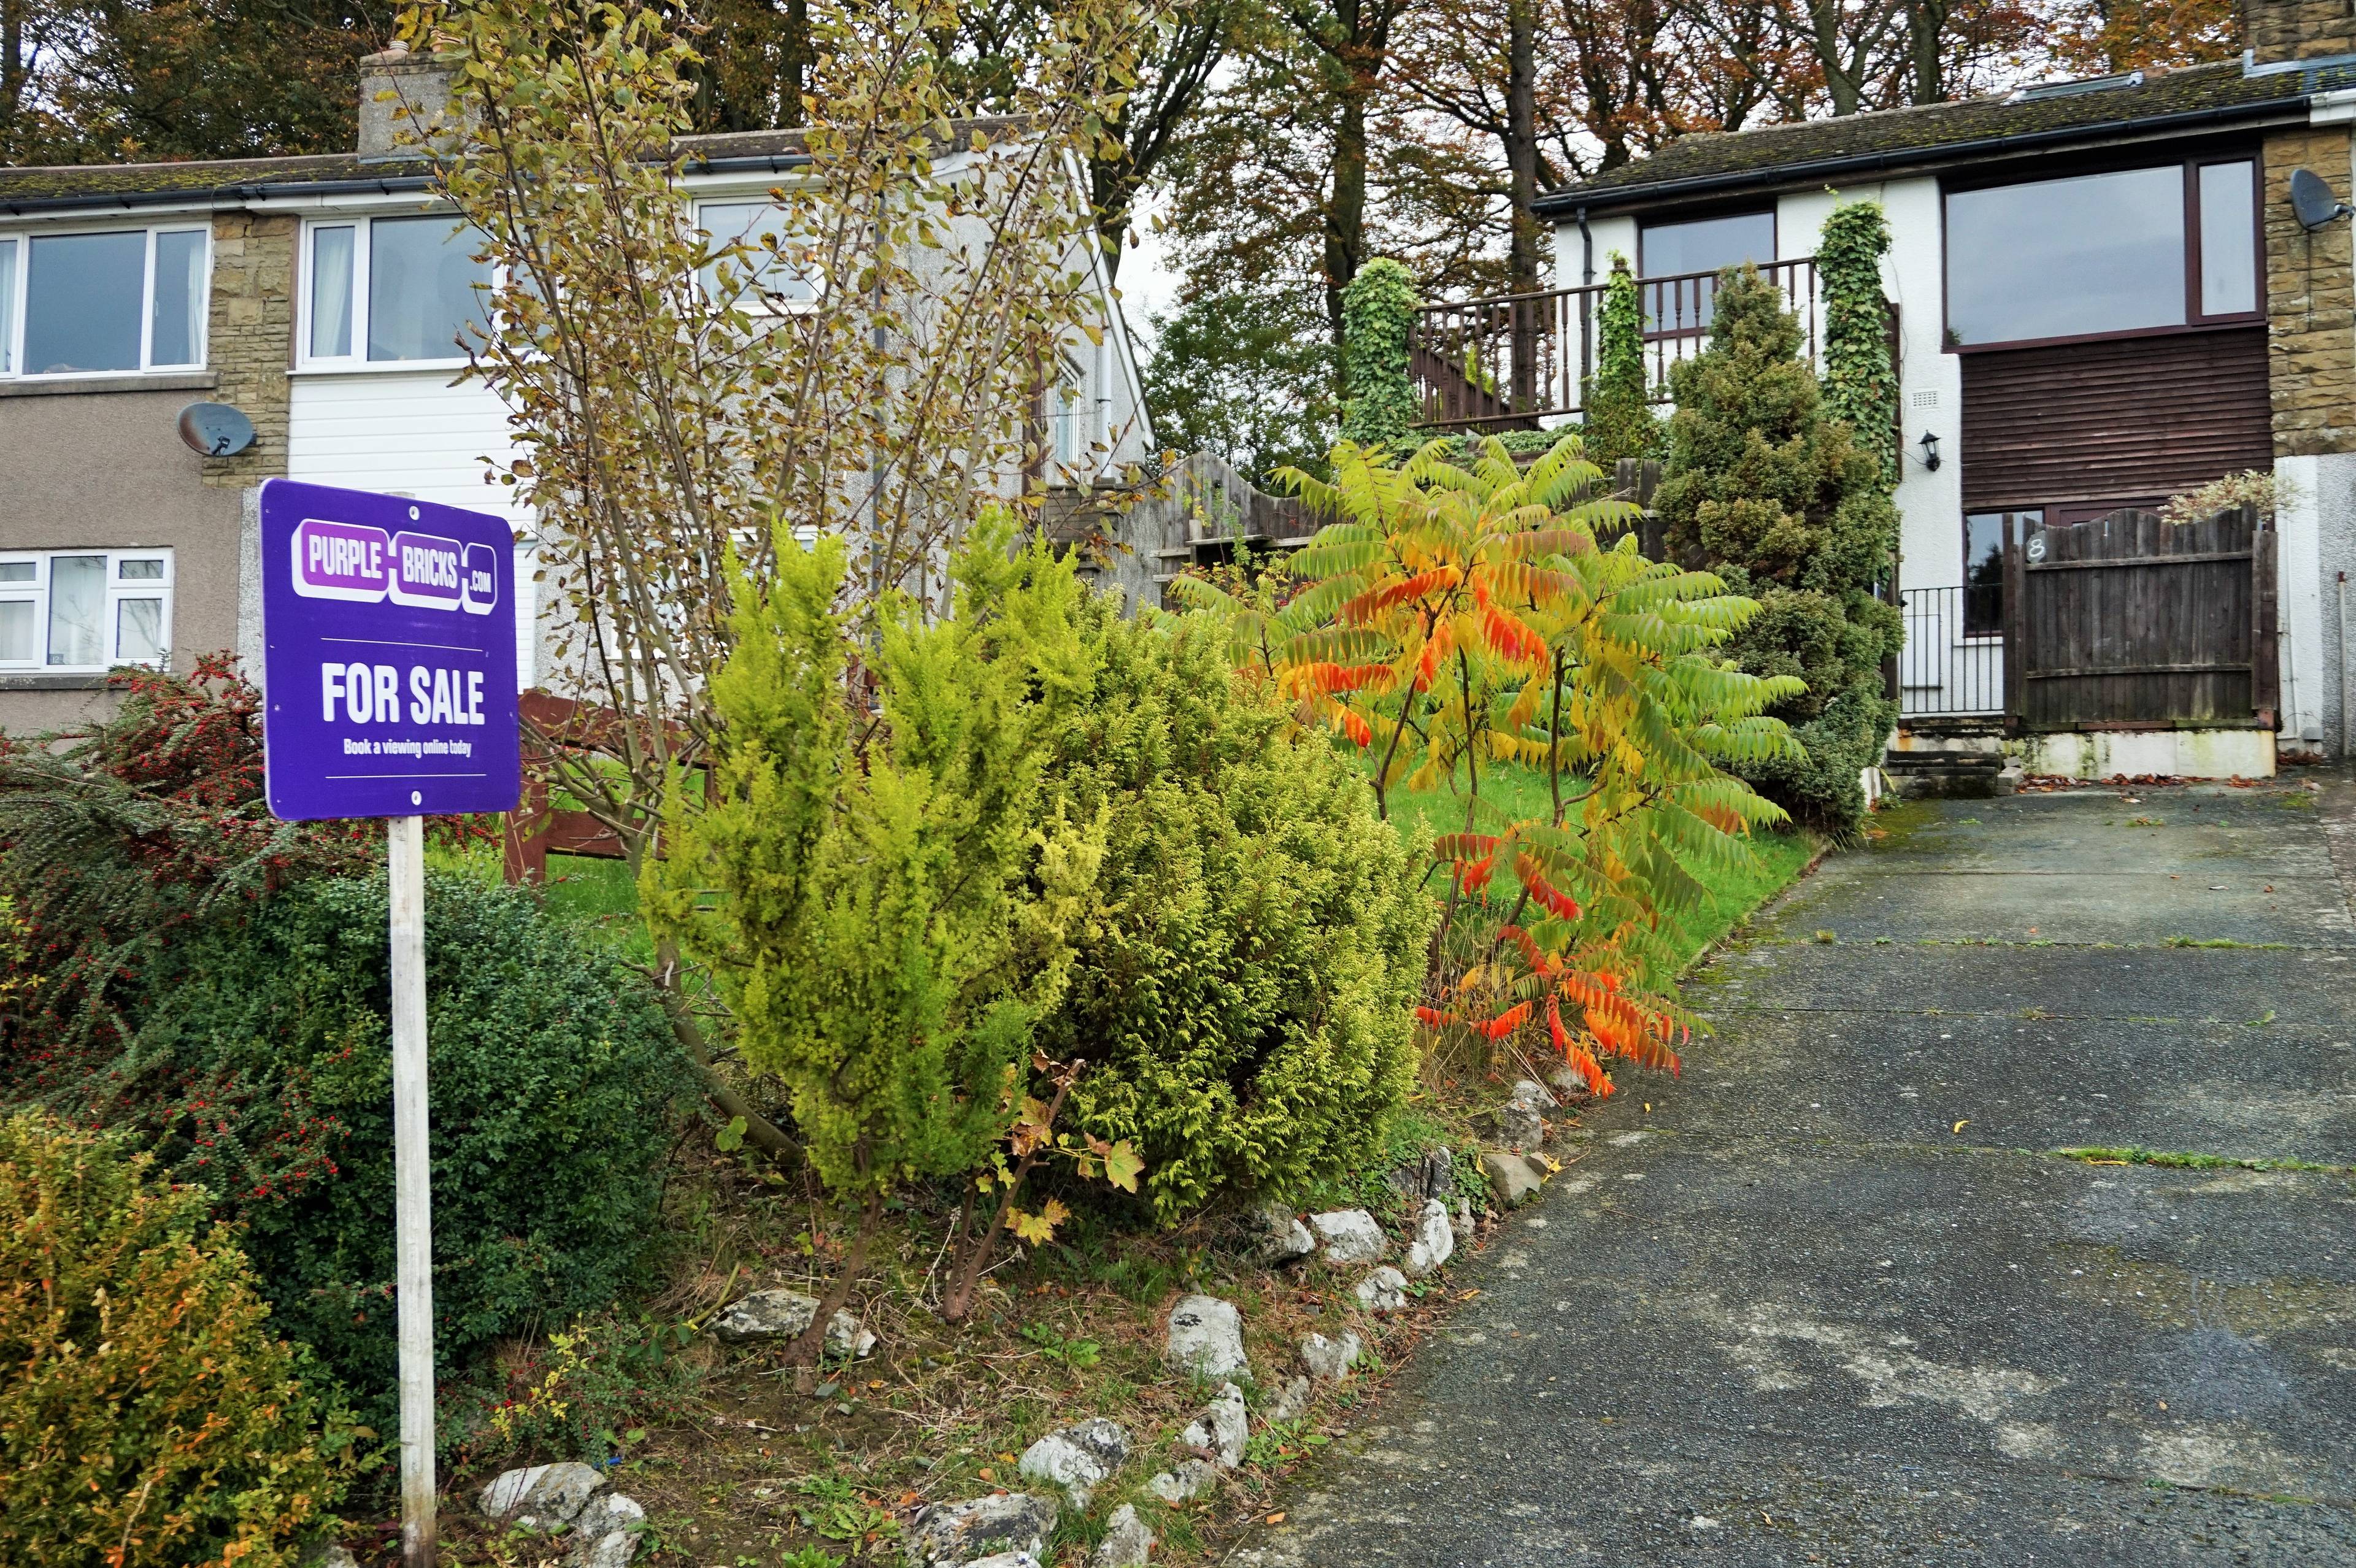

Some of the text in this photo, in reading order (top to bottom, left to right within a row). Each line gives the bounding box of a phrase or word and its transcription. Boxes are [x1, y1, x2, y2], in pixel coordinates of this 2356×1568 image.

[309, 534, 491, 593] PURPLE BRICKS .COM
[2030, 539, 2044, 557] 8
[321, 662, 485, 725] FOR SALE
[344, 738, 472, 759] Book a viewing online today
